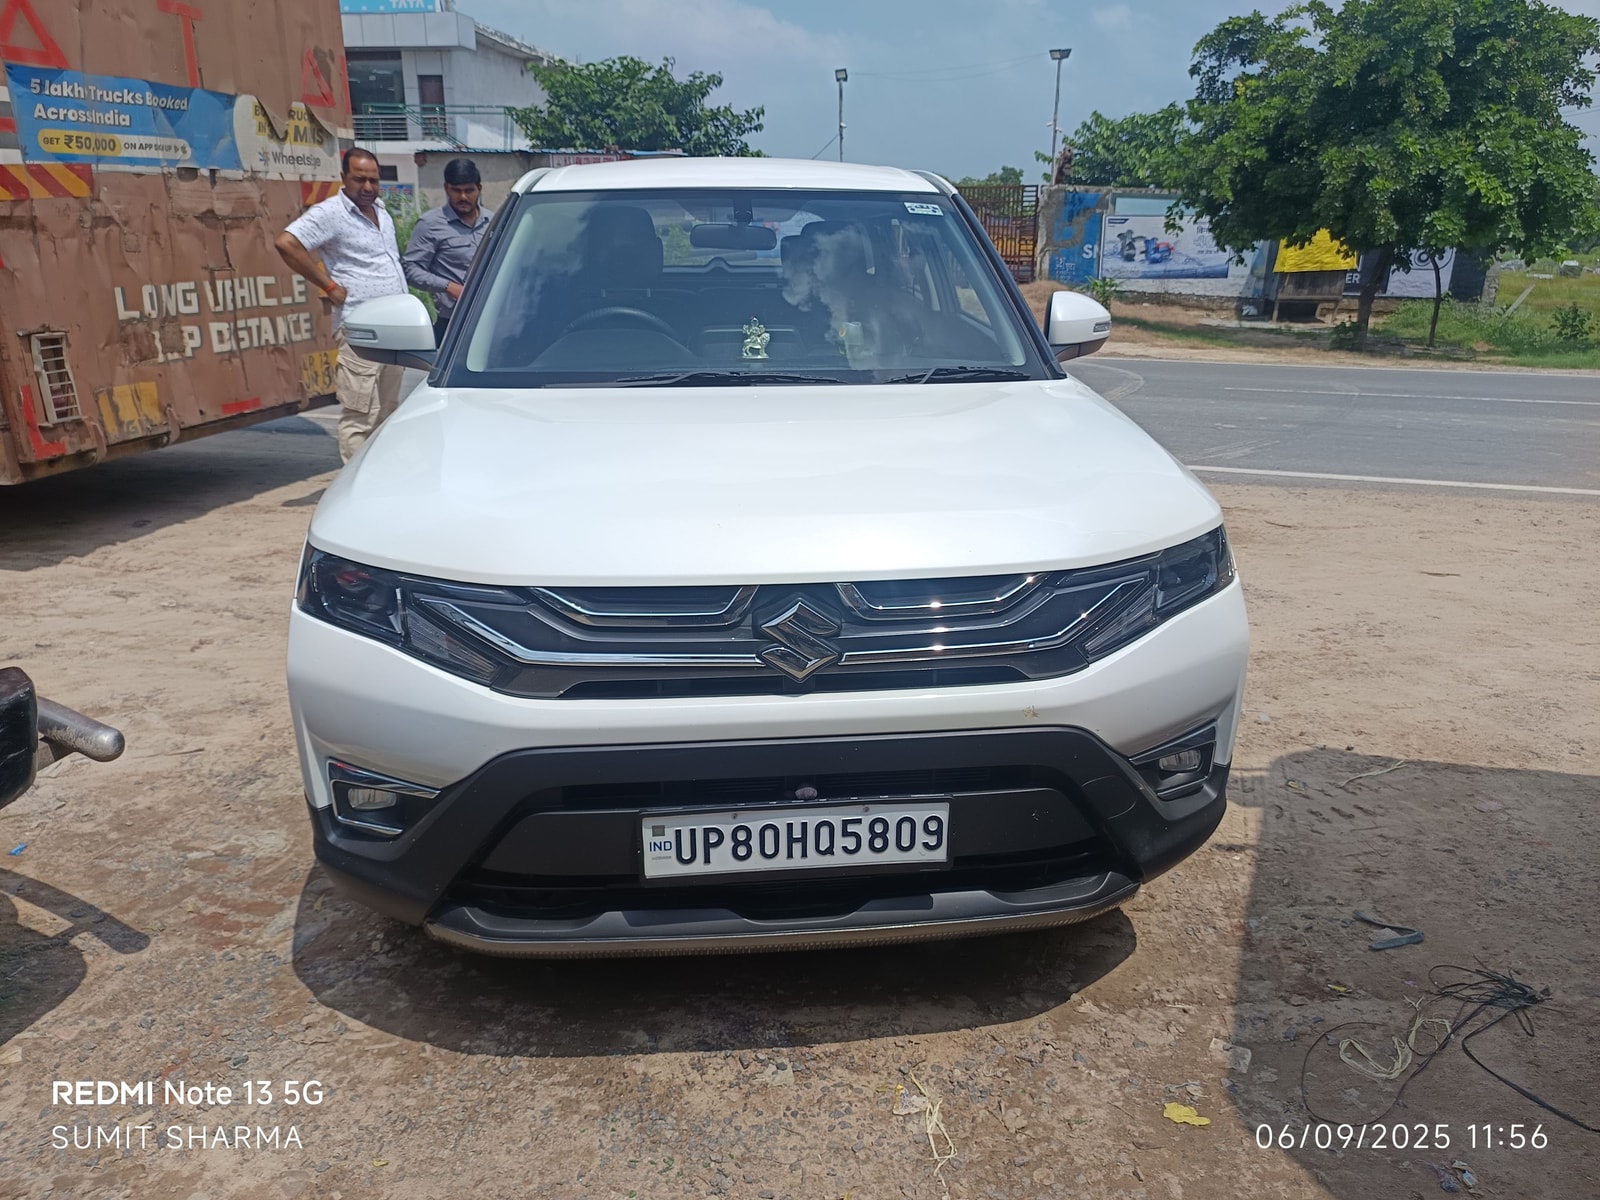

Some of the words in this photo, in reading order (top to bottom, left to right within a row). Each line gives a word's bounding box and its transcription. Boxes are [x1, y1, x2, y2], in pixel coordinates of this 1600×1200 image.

[30, 78, 41, 94] 5
[89, 86, 143, 104] Trucks
[145, 91, 188, 110] Booked
[43, 136, 60, 145] GET
[123, 142, 137, 150] ON
[138, 143, 153, 151] APP
[114, 281, 200, 321] LONG
[208, 312, 311, 353] DISTANCE
[649, 840, 672, 851] IND
[674, 814, 944, 865] UP80HQ5809
